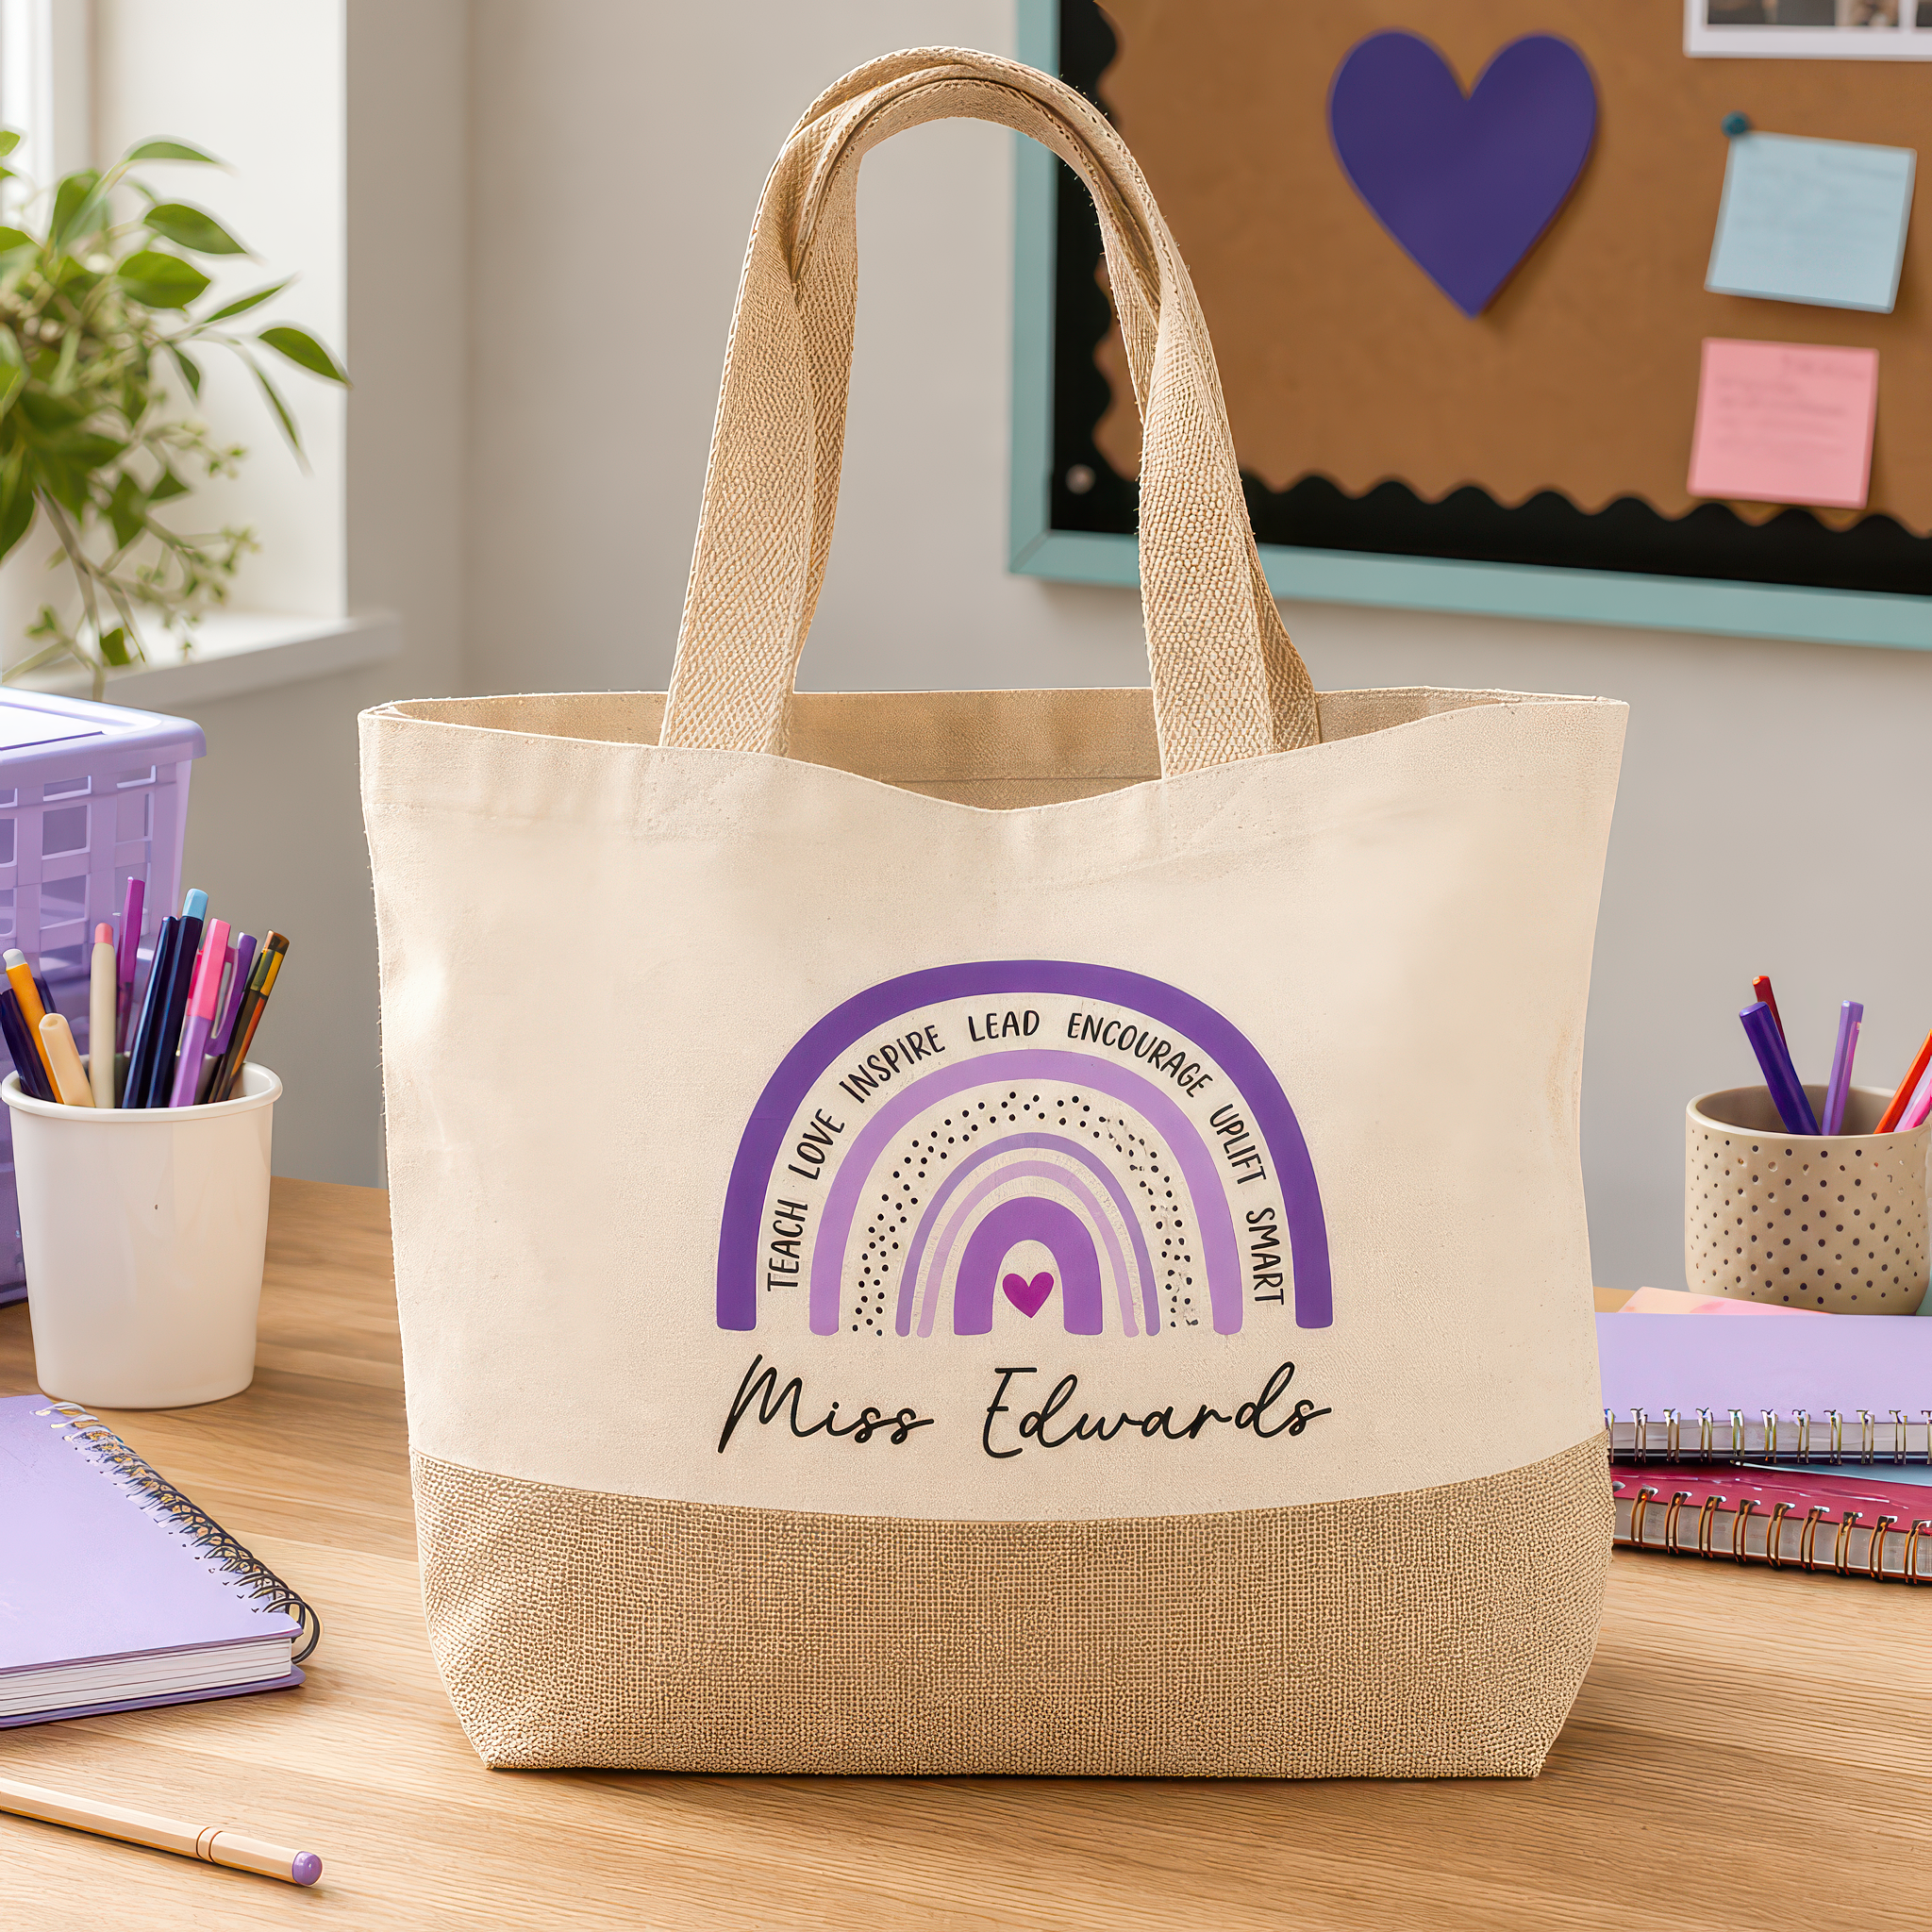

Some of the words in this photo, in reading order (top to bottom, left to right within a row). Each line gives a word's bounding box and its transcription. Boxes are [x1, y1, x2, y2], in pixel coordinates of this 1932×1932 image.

[767, 1199, 808, 1292] TEACH
[788, 1108, 845, 1181] LOVE
[839, 1024, 945, 1104] INSPIRE
[968, 1009, 1040, 1042] LEAD
[1067, 1012, 1213, 1098] ENCOURAGE
[1208, 1103, 1267, 1185] UPLIFT
[1245, 1208, 1285, 1306] SMART
[717, 1354, 935, 1454] Miss
[982, 1361, 1332, 1459] Edwards
